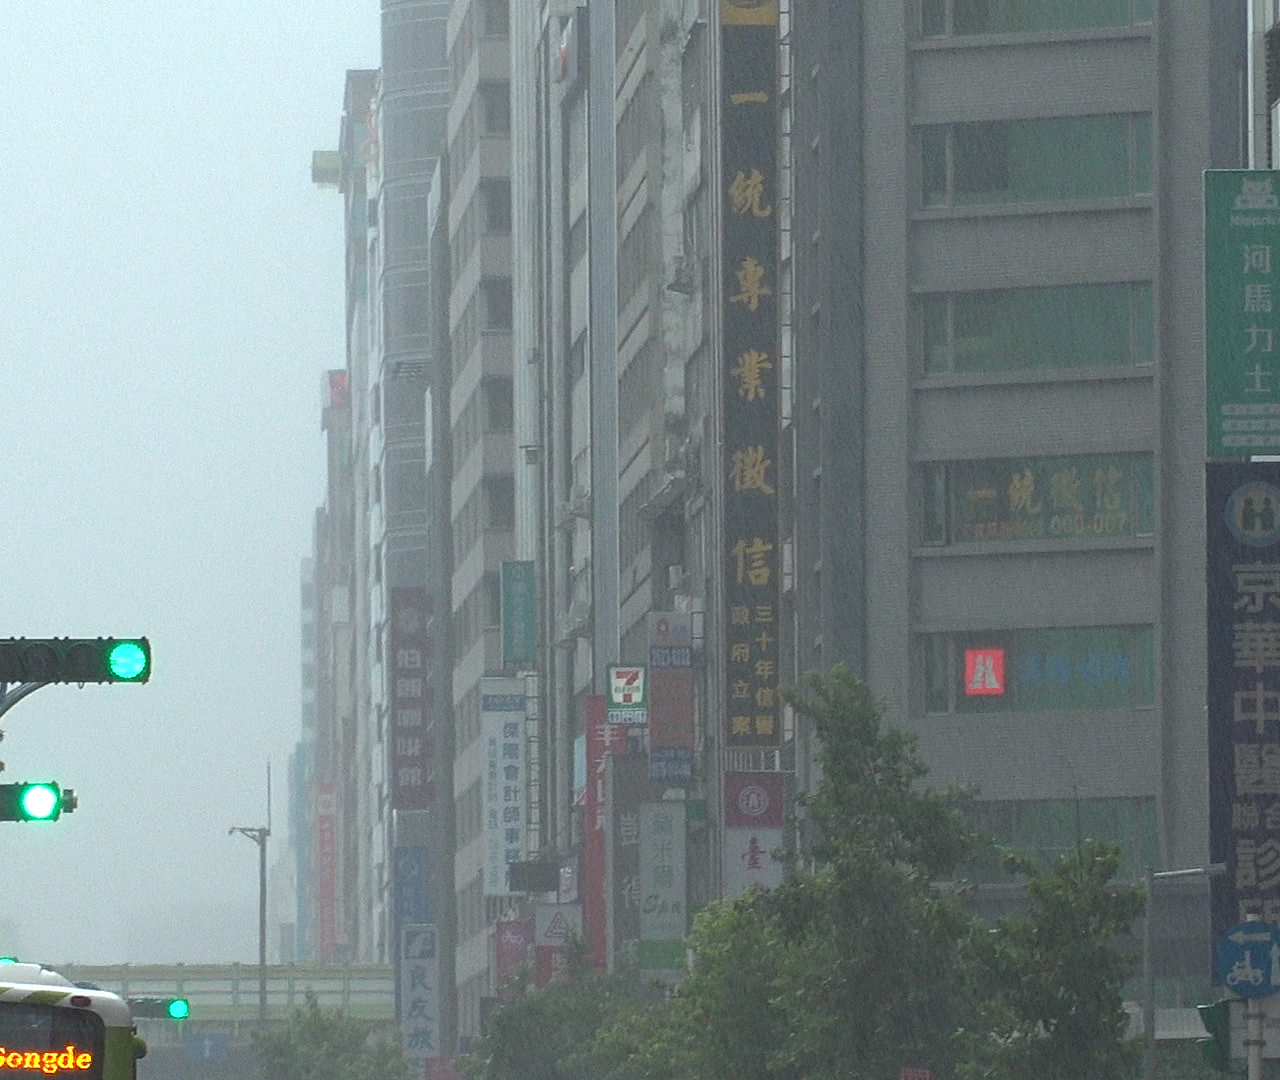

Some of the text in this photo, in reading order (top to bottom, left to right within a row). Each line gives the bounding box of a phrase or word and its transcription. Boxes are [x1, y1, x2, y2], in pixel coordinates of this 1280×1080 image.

[728, 90, 775, 588] 一統專業徵信
[1243, 243, 1272, 394] 河馬力士
[616, 670, 639, 702] 7
